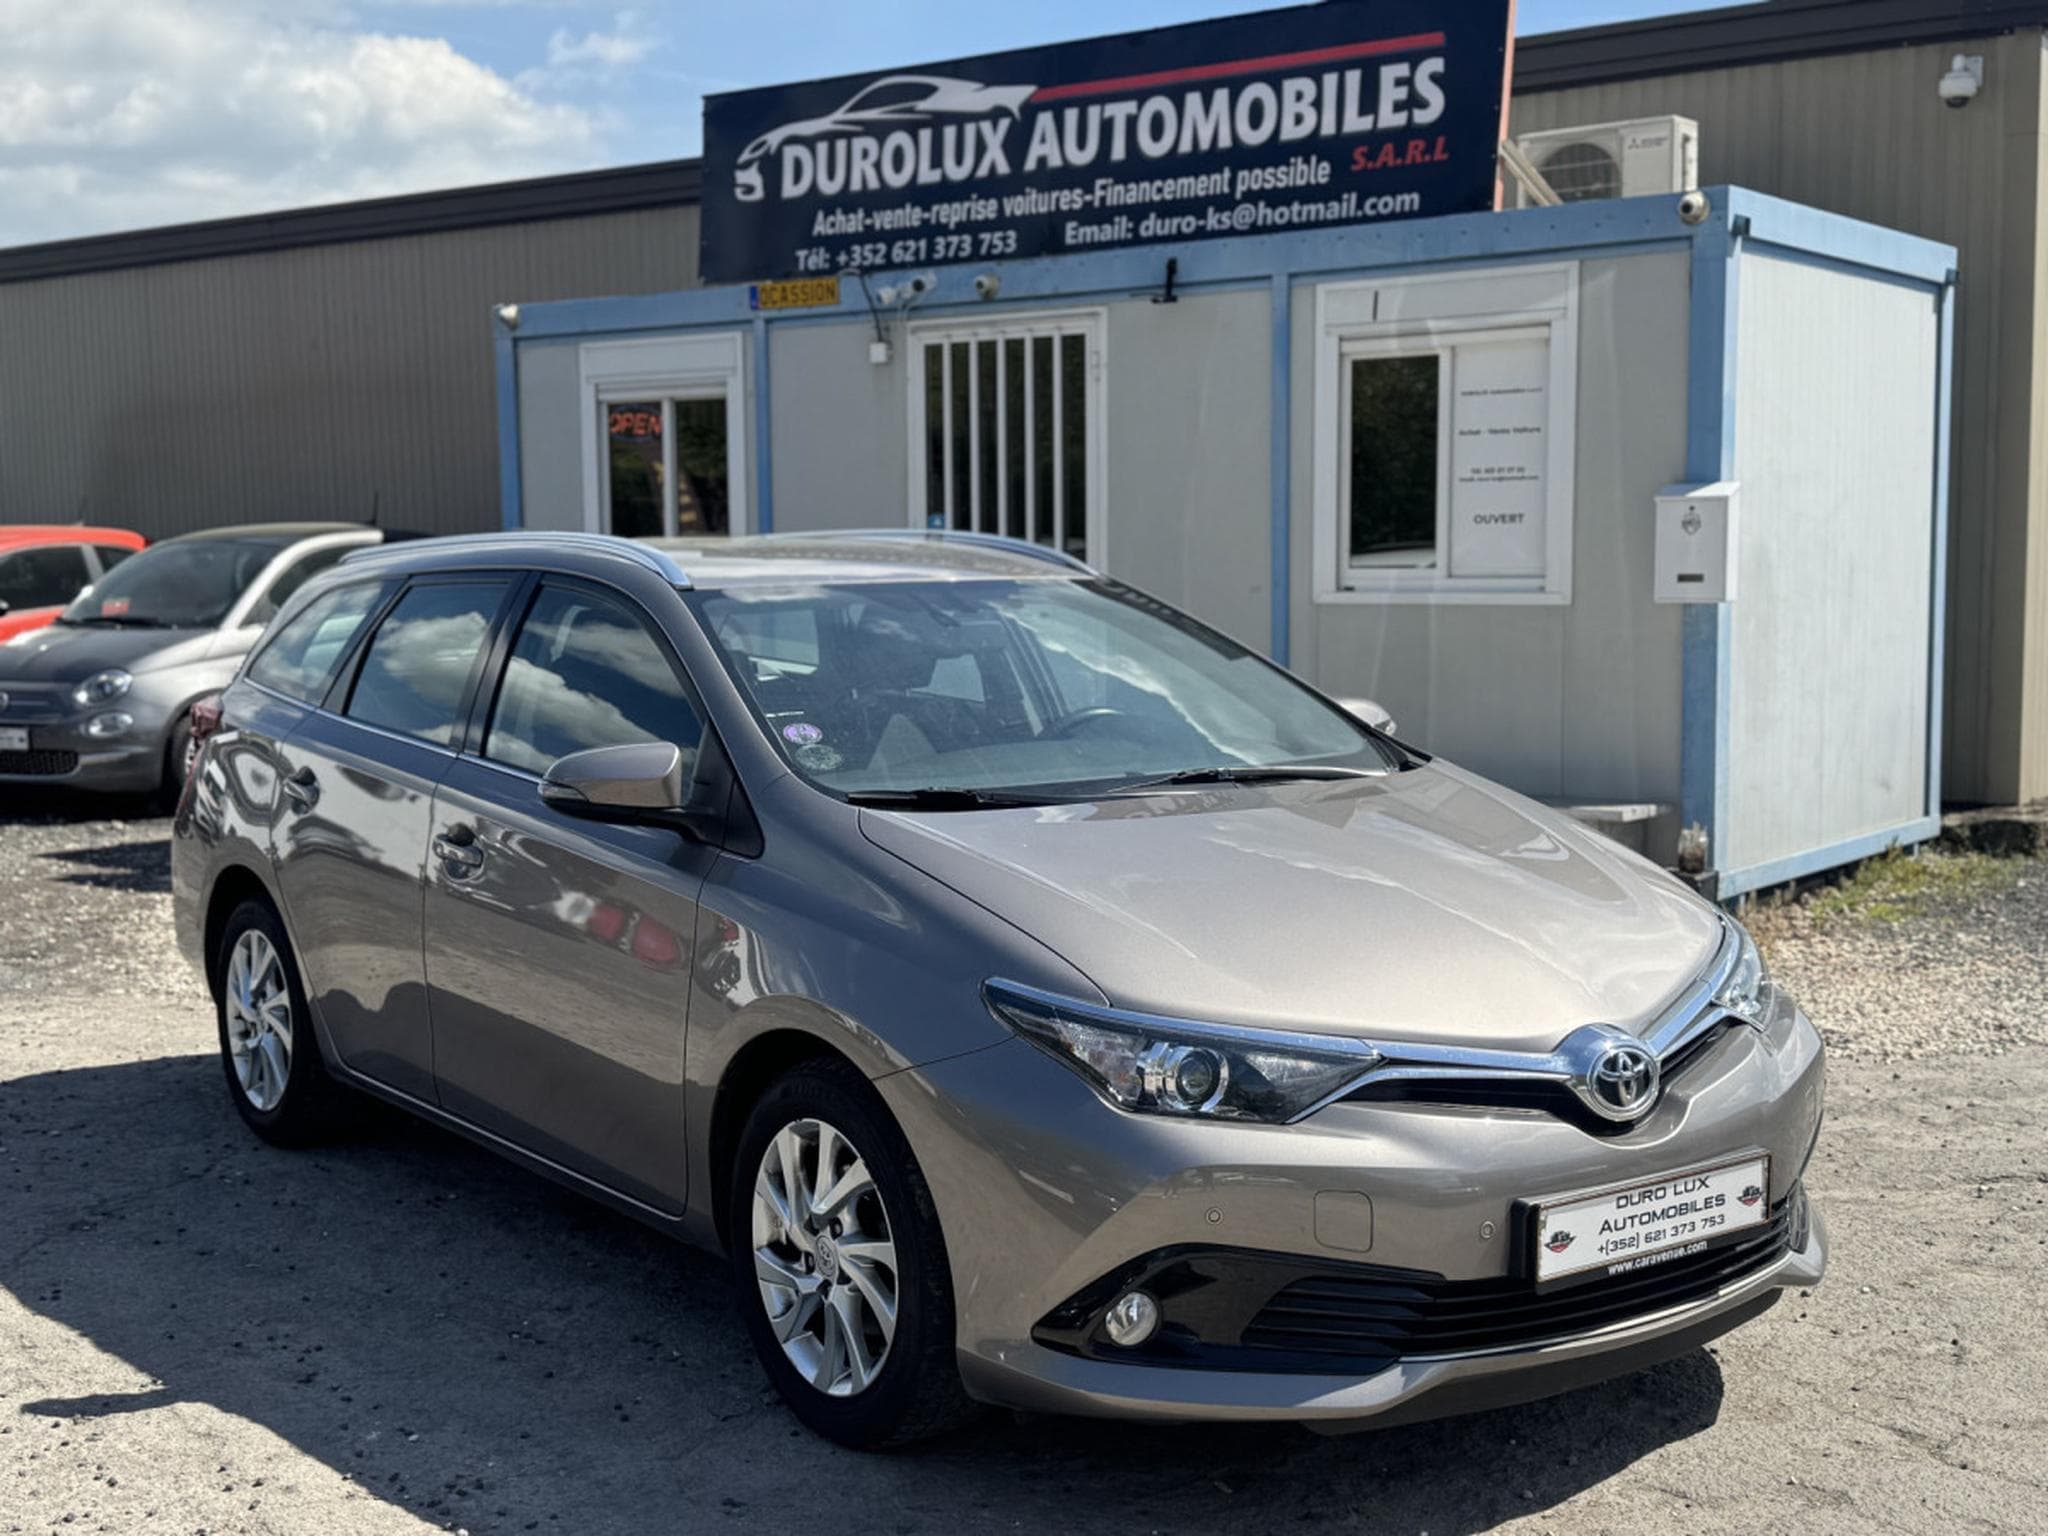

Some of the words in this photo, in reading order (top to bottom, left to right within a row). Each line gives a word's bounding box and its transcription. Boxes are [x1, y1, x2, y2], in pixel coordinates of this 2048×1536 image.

[781, 117, 1011, 199] DUROLUX
[1023, 56, 1446, 172] AUTOMOBILES
[1350, 135, 1450, 171] S.A.R.L
[812, 193, 998, 237] Achat-vente-reprise
[1002, 165, 1232, 218] voitures-Financement
[1235, 154, 1332, 200] possible
[1064, 214, 1134, 246] Email:
[1139, 190, 1421, 238] duro-ks@hotmail.com
[795, 246, 831, 272] Tél:
[836, 242, 888, 268] +352
[891, 237, 928, 264] 621
[933, 233, 973, 260] 373
[978, 229, 1018, 256] 753
[1473, 512, 1526, 525] OUVERT
[1615, 1186, 1668, 1210] DURO
[1673, 1175, 1711, 1197] LUX
[1597, 1231, 1641, 1256] +(352)
[1644, 1228, 1668, 1244] 621
[1670, 1220, 1697, 1238] 373
[1700, 1213, 1726, 1230] 753
[1598, 1193, 1727, 1236] AUTOMOBILES
